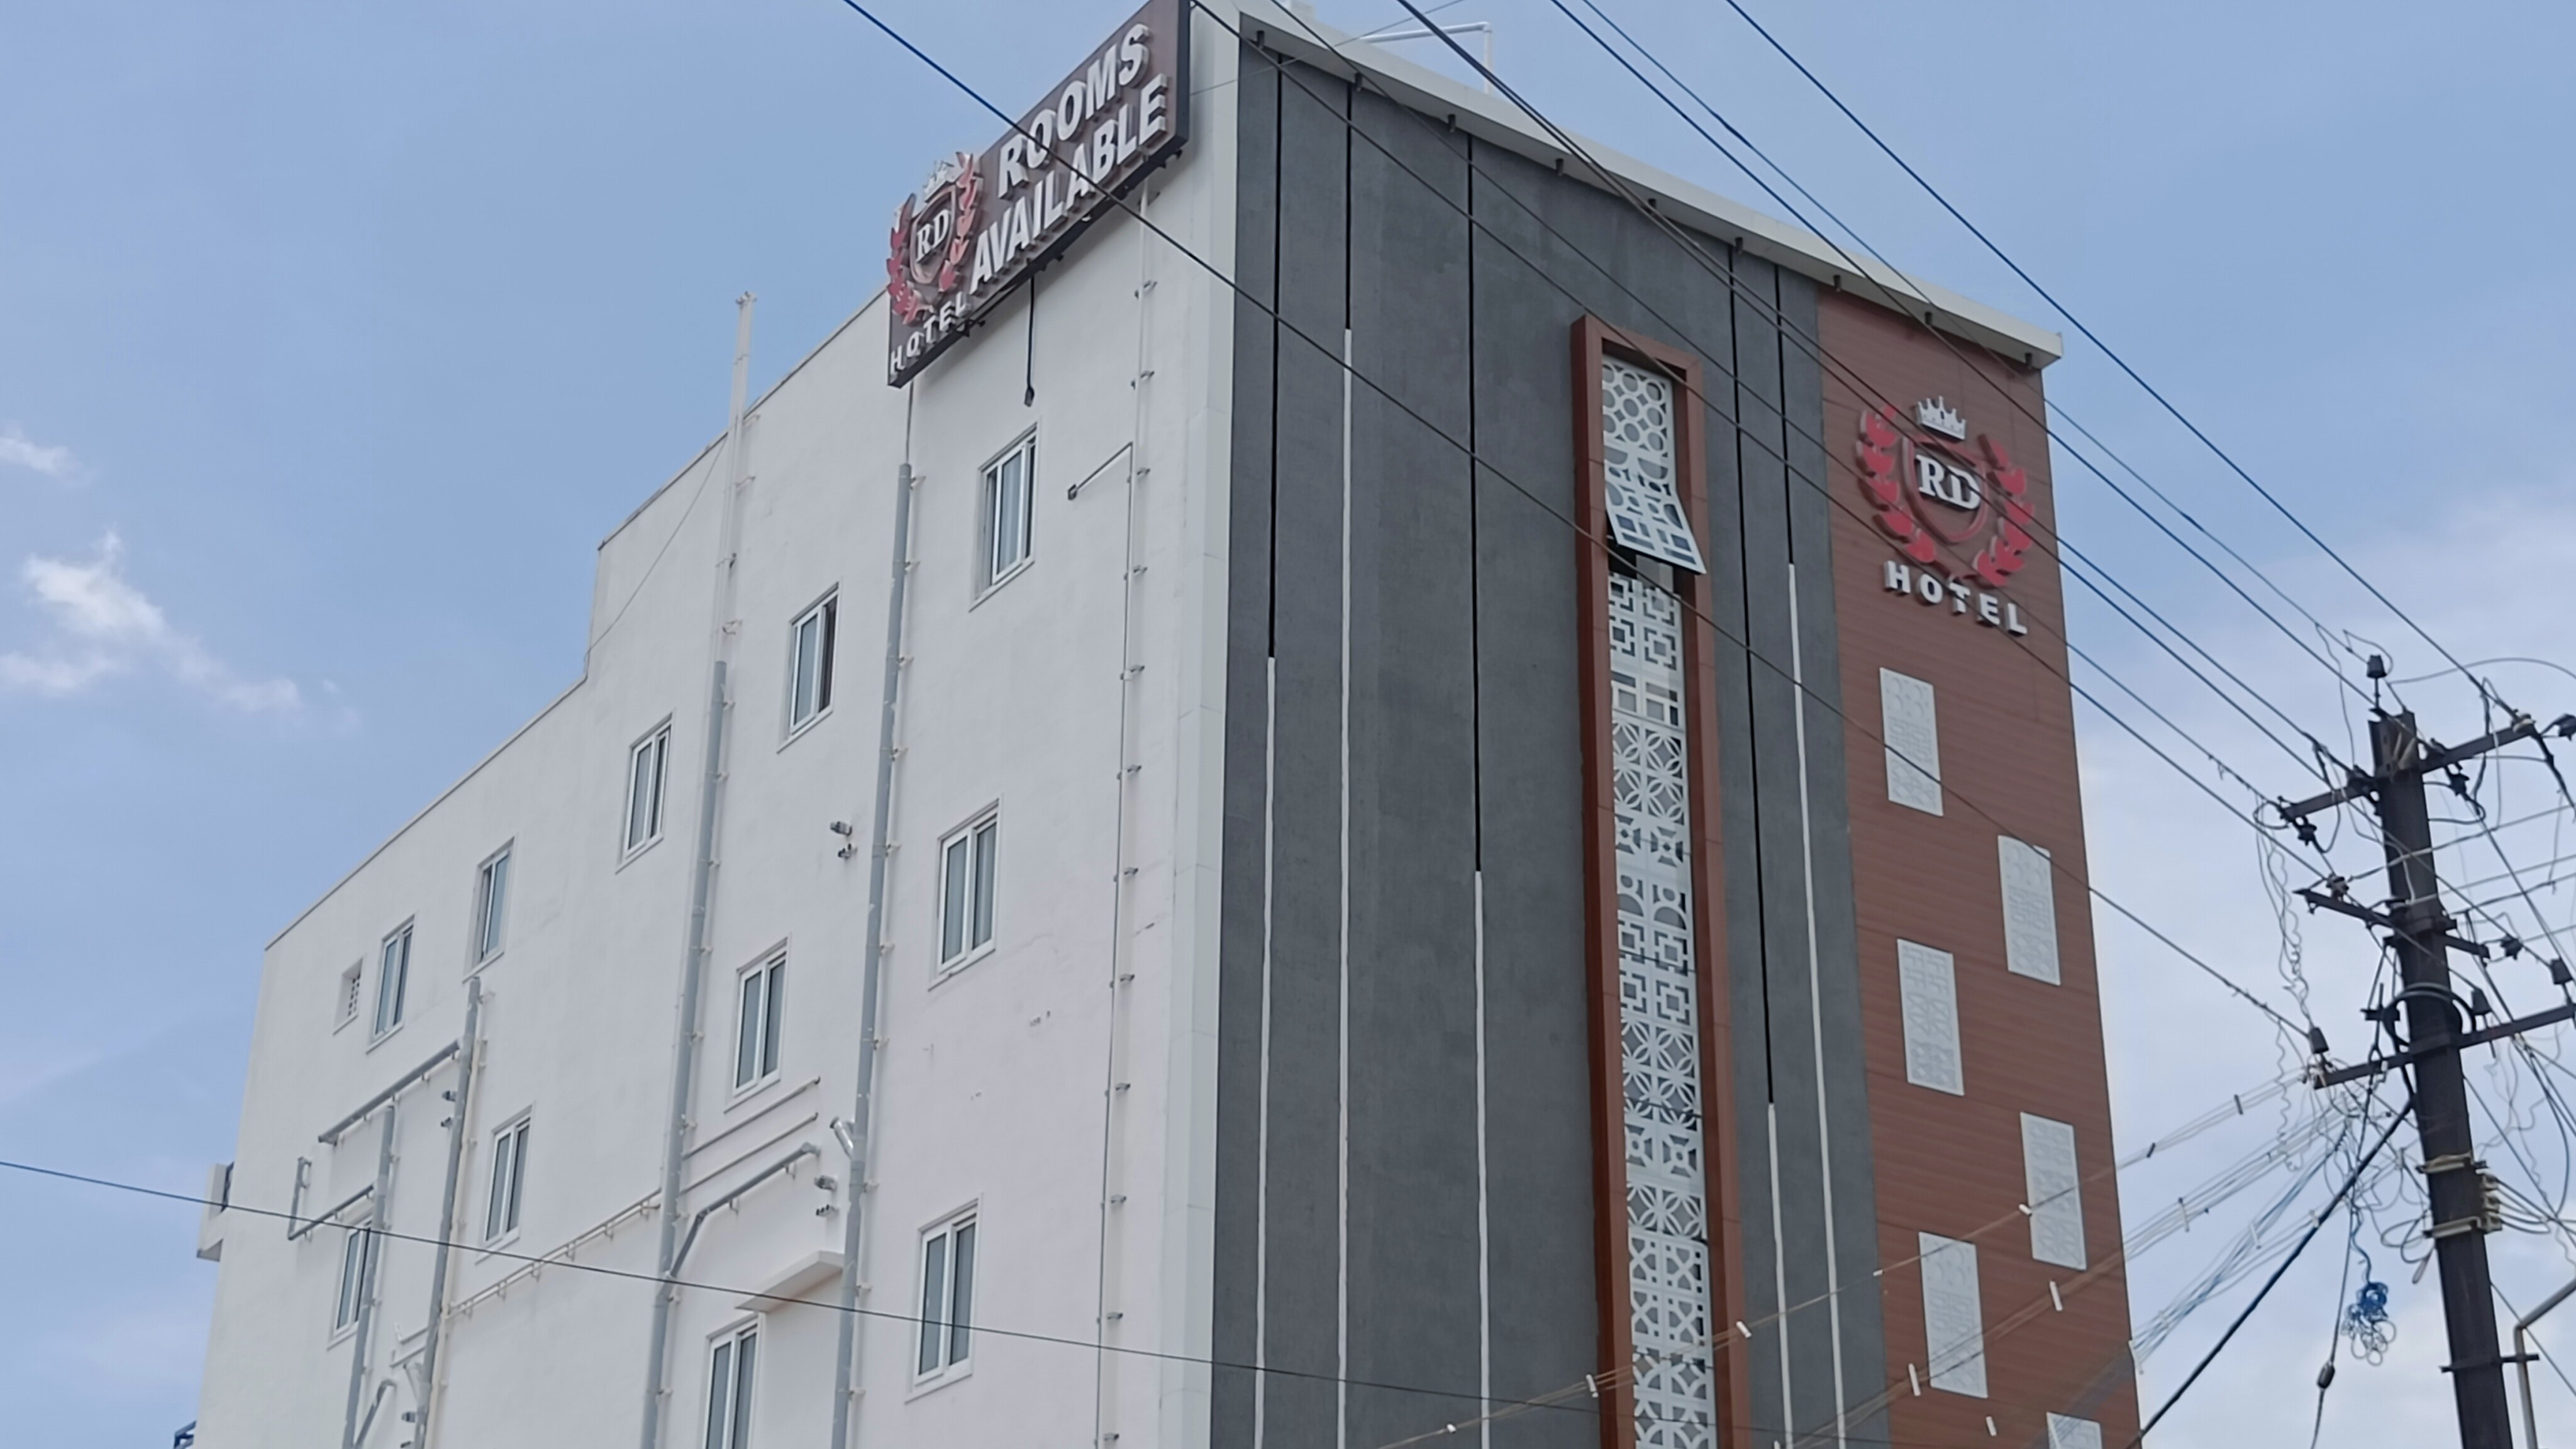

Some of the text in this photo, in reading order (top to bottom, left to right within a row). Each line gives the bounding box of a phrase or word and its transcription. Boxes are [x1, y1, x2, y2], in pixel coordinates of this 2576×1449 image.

[999, 23, 1149, 199] ROOMS
[969, 74, 1167, 296] AVAILABLE
[914, 209, 952, 264] RD
[891, 291, 971, 375] HOTEL
[1916, 454, 1981, 510] RD
[1885, 560, 2027, 634] HOTEL
